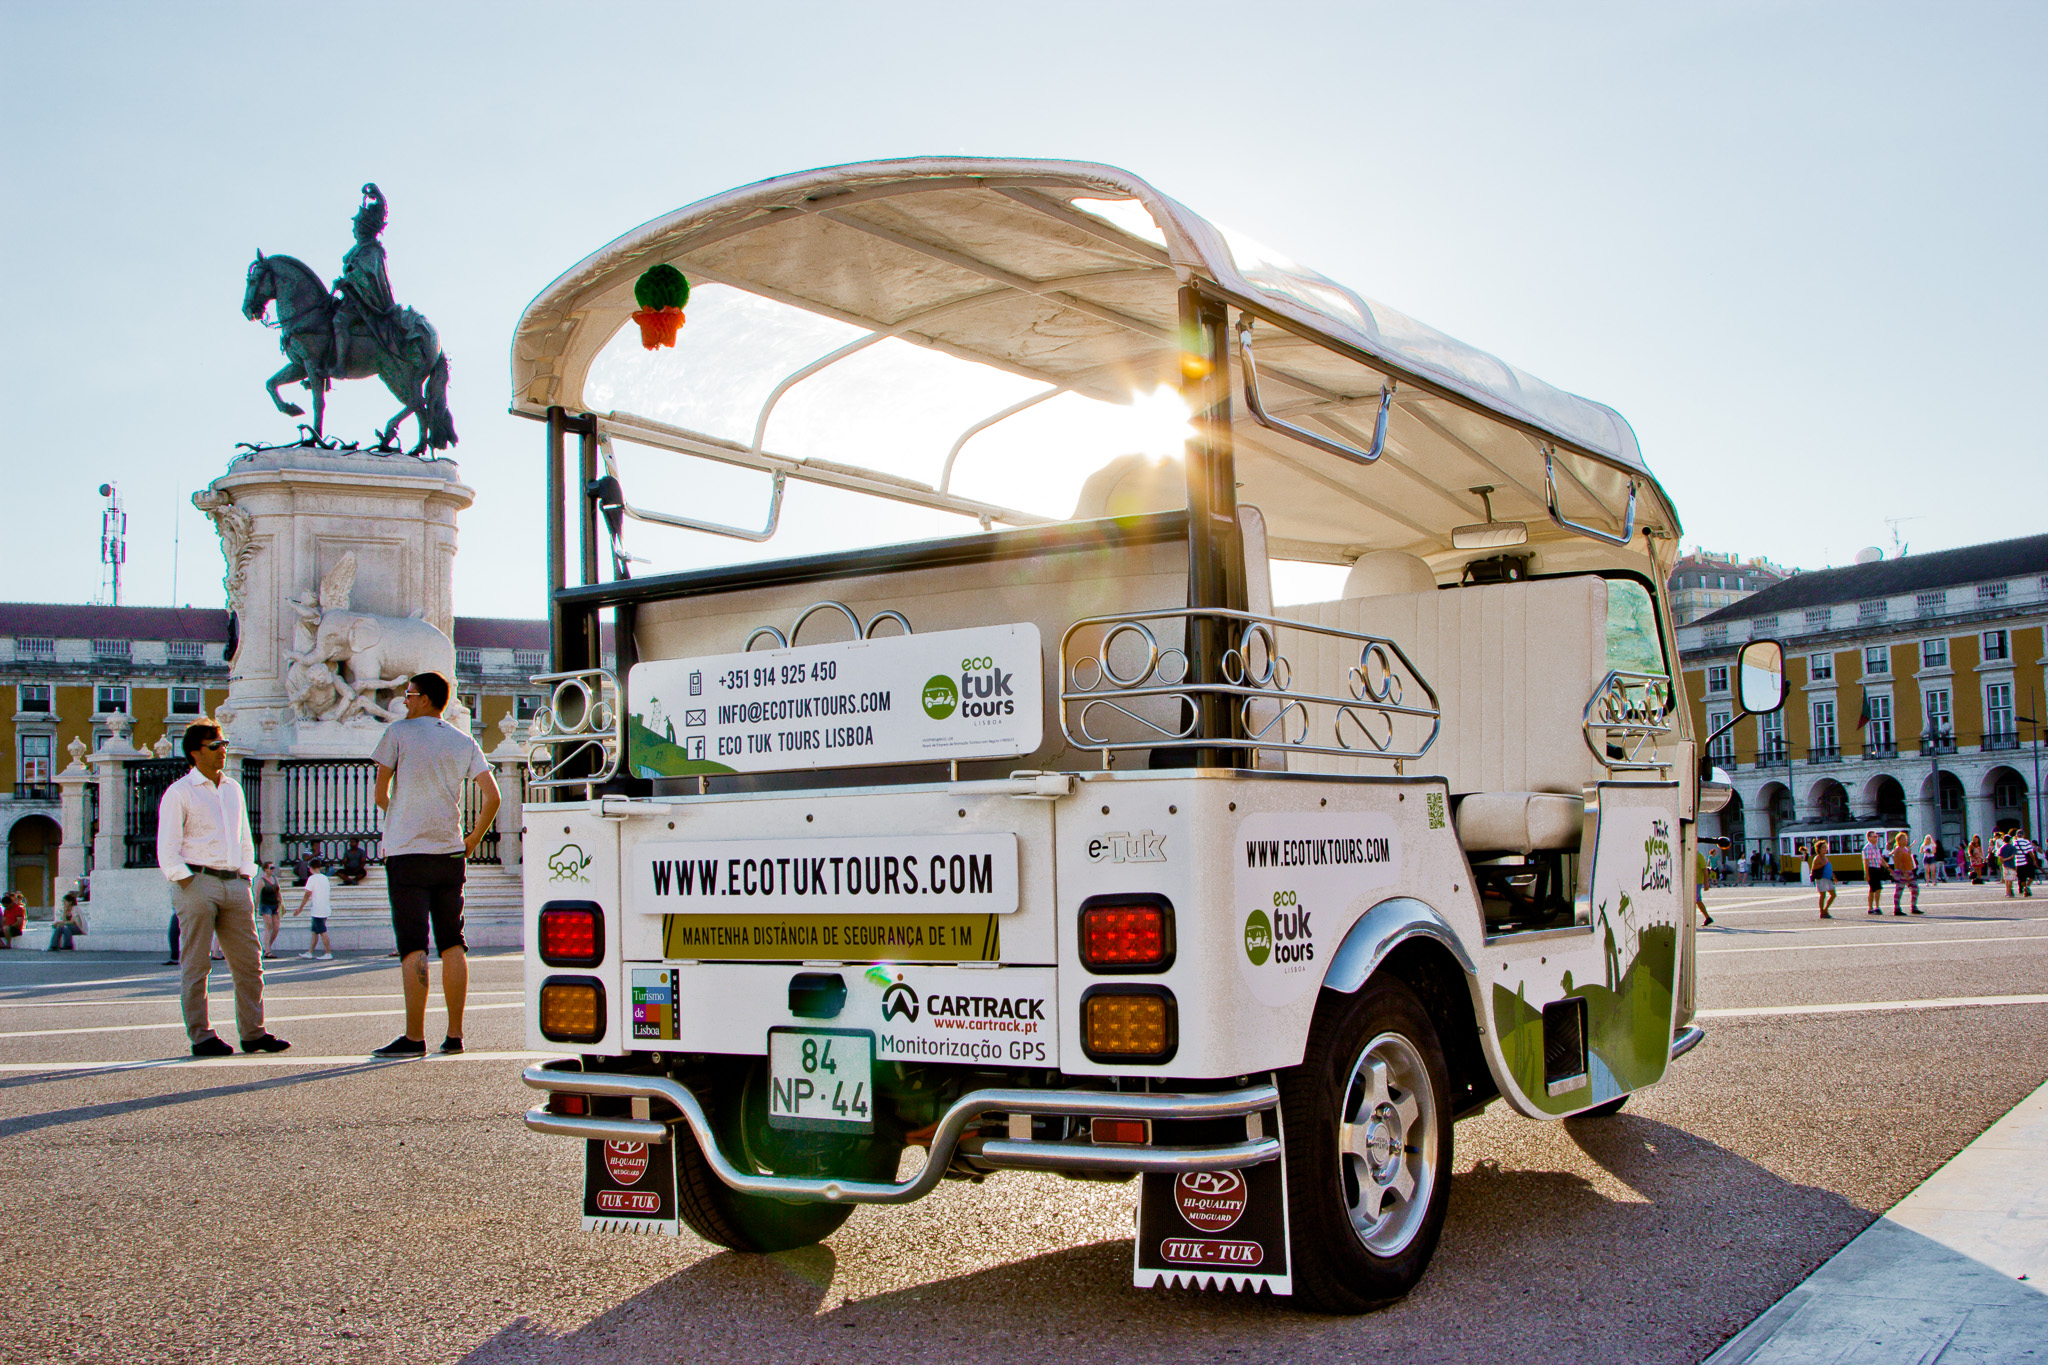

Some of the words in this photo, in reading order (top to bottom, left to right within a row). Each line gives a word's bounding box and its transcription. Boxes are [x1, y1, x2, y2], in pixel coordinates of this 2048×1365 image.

[962, 656, 992, 671] eco
[718, 669, 749, 690] +351
[754, 667, 776, 687] 914
[782, 664, 805, 684] 925
[811, 661, 836, 682] 450
[962, 668, 1014, 699] tuk
[718, 691, 890, 724] INFO@ECOTUKTOURS.COM
[962, 700, 1014, 718] tours
[718, 735, 742, 756] ECO
[748, 733, 772, 754] TUK
[778, 730, 820, 752] TOURS
[826, 726, 874, 748] LISBOA
[1652, 819, 1669, 839] Think
[1246, 838, 1390, 868] WWW.ECOTUKTOURS.COM
[652, 854, 993, 896] WWW.ECOTUKTOURS.COM
[1273, 890, 1297, 907] eco
[1274, 904, 1312, 941] tuk
[682, 926, 749, 946] MANTENHA
[754, 922, 818, 946] DISTÂNCIA
[824, 926, 839, 945] DE
[844, 926, 924, 948] SEGURANÇA
[929, 926, 946, 945] DE
[1275, 942, 1314, 964] tours
[1284, 966, 1306, 974] LISBOA
[633, 990, 664, 1000] Turismo
[634, 1008, 644, 1018] de
[927, 994, 1046, 1020] CARTRACK
[634, 1024, 660, 1036] Lisboa
[934, 1018, 1038, 1036] www.cartrack.pt
[802, 1038, 837, 1075] 84
[881, 1034, 1002, 1062] Monitorização
[1009, 1041, 1046, 1062] GPS
[610, 1157, 646, 1166] HI-QUALITY
[602, 1194, 623, 1207] TUK
[632, 1196, 656, 1208] TUK
[1183, 1198, 1243, 1210] HI-QUALITY
[1188, 1212, 1232, 1222] MUDGUARD
[1168, 1242, 1204, 1258] TUK
[1218, 1244, 1256, 1261] TUK
